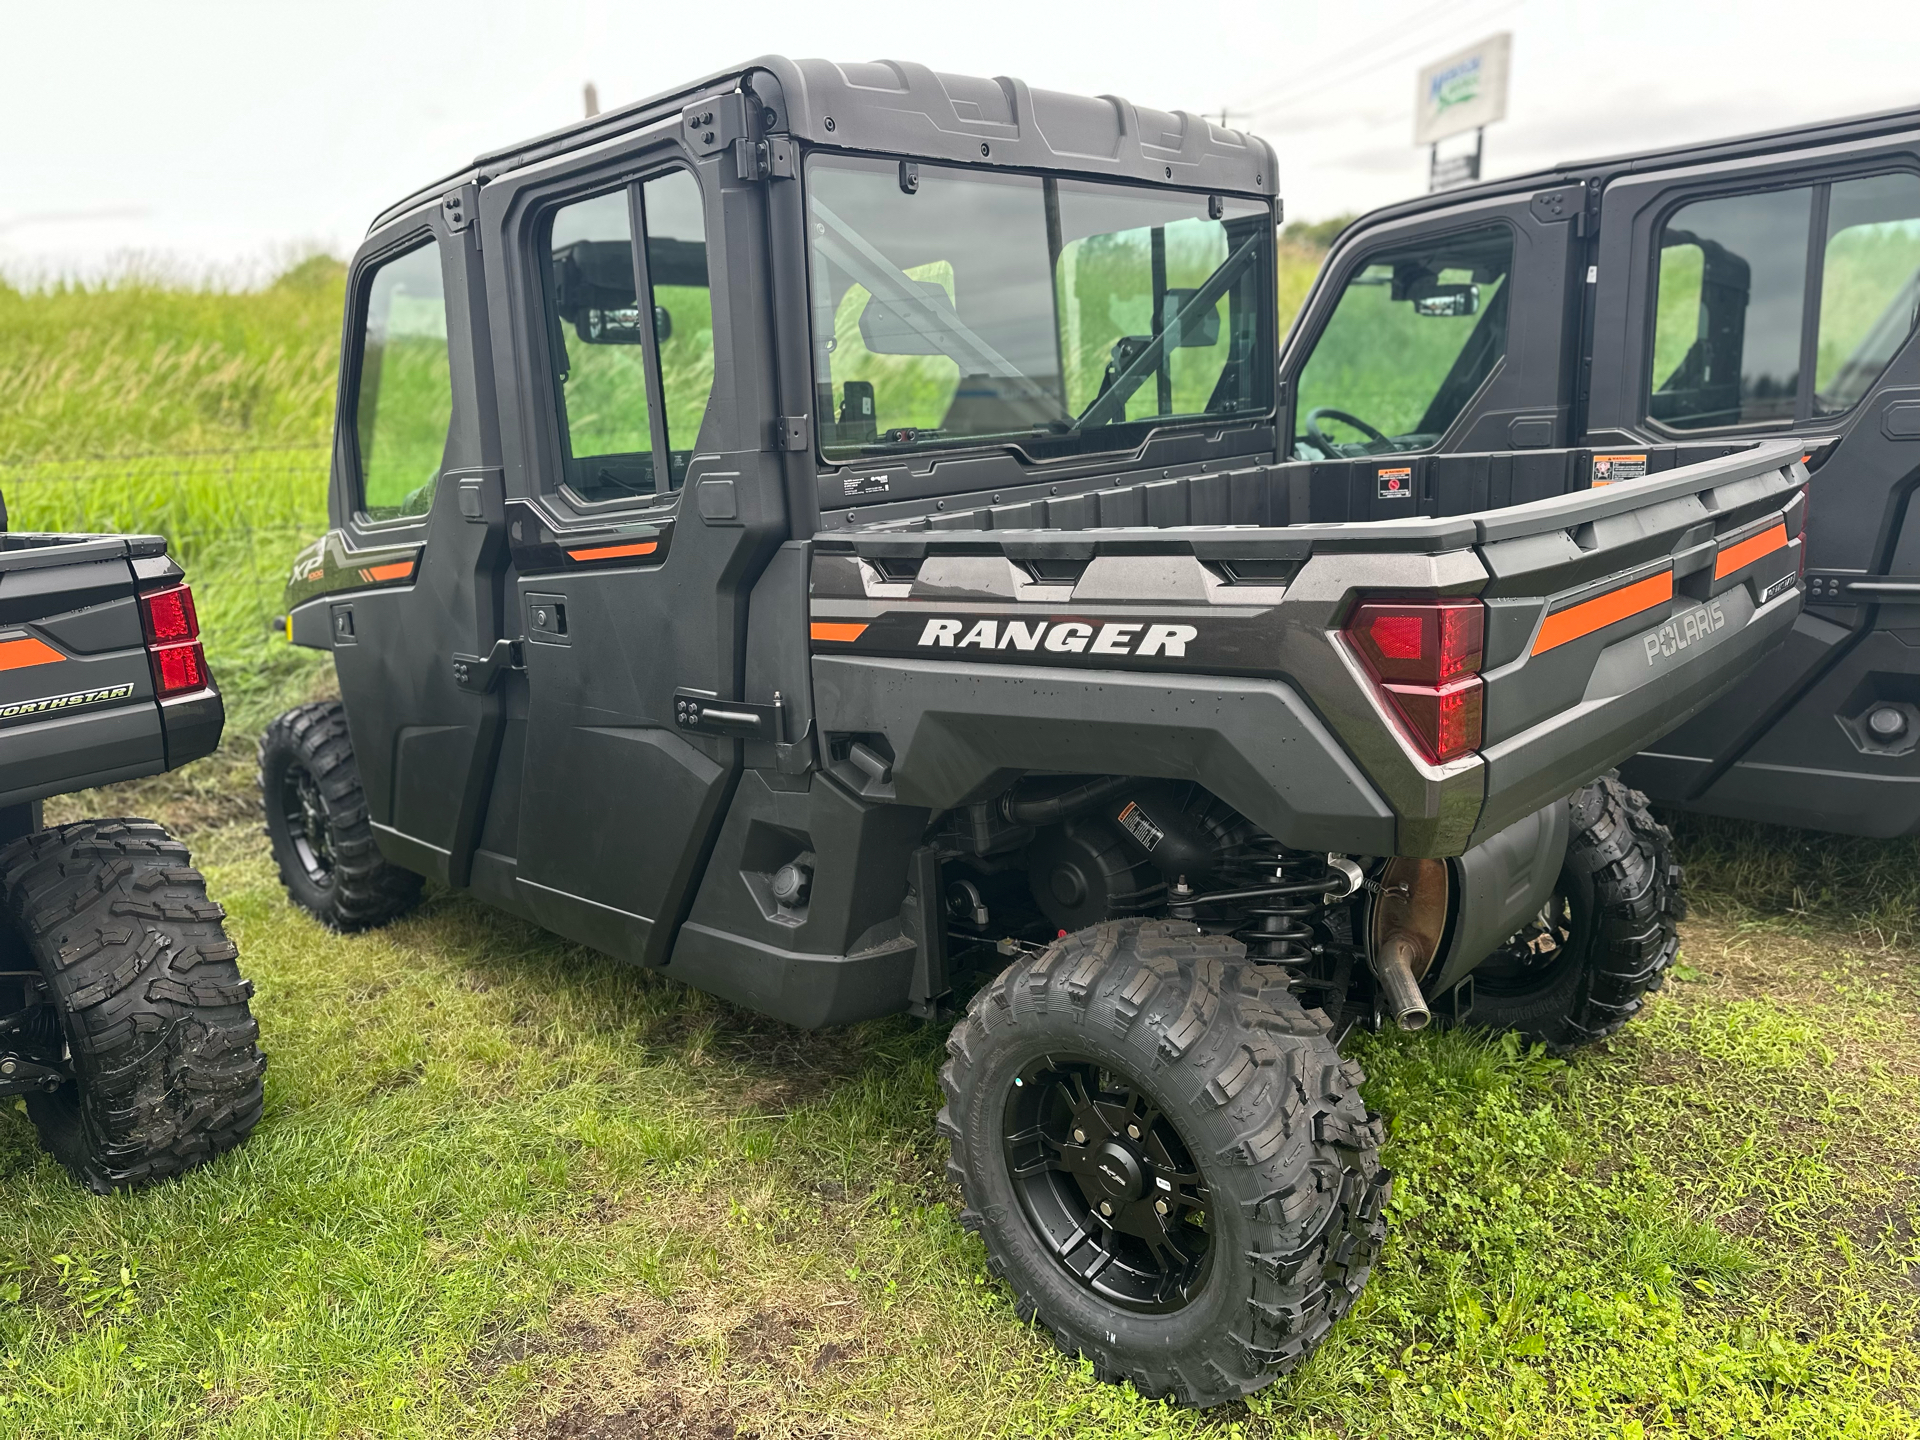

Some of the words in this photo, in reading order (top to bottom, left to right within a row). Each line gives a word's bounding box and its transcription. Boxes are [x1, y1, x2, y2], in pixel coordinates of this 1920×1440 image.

[289, 555, 324, 586] XP
[917, 618, 1198, 657] RANGER
[1643, 600, 1725, 667] POLARIS
